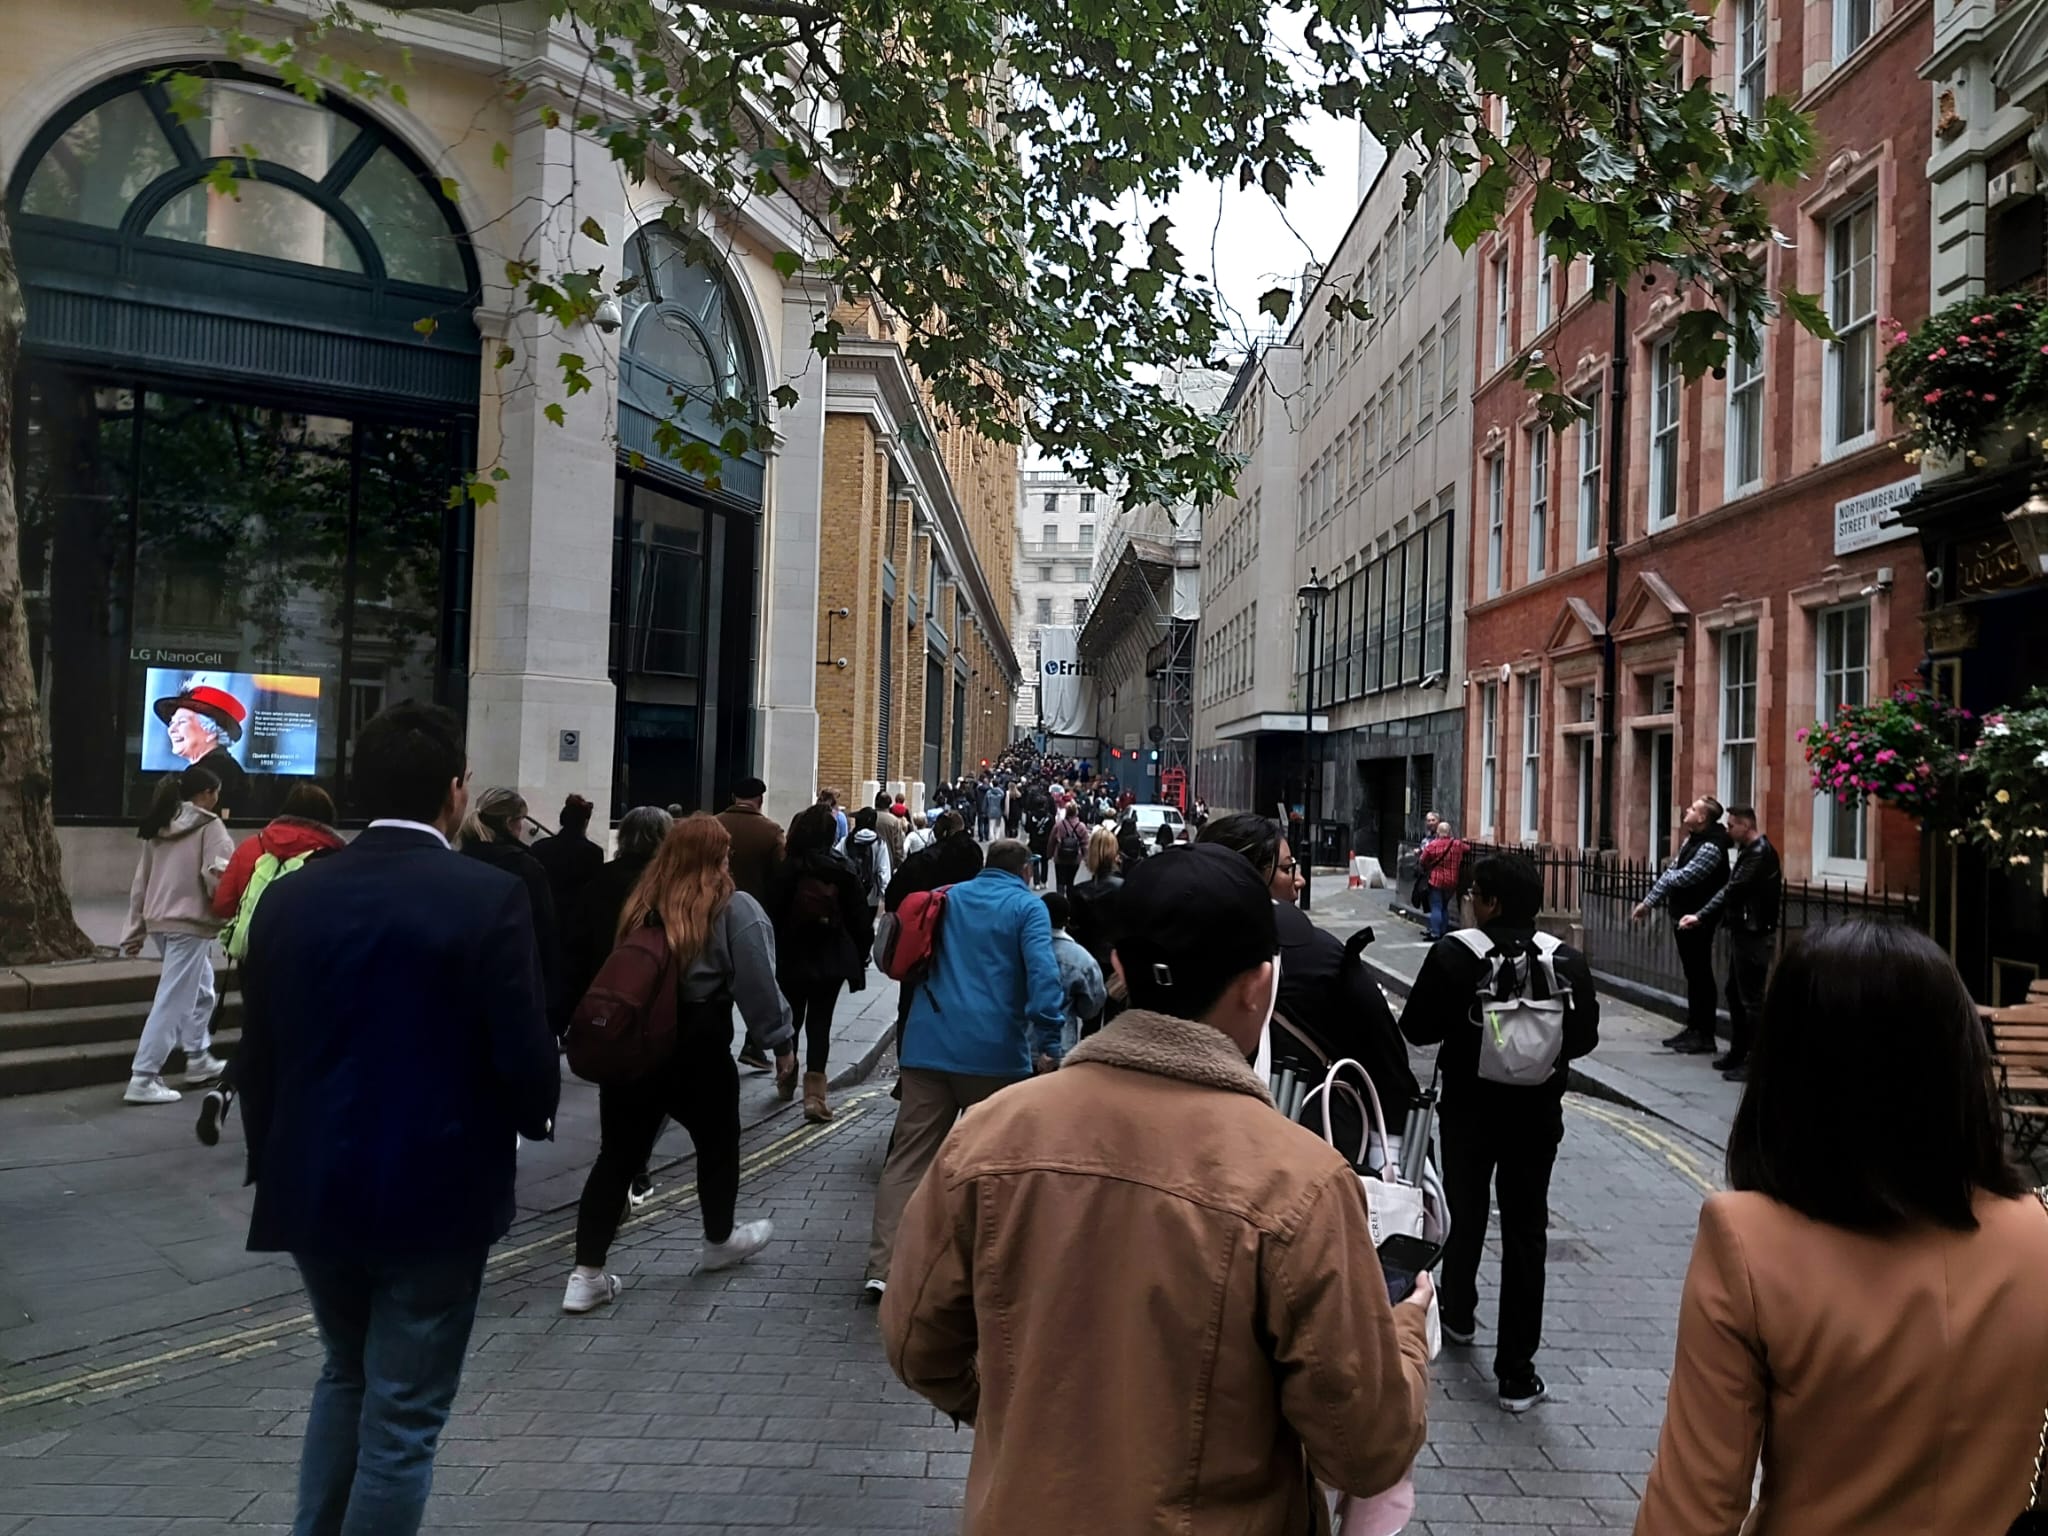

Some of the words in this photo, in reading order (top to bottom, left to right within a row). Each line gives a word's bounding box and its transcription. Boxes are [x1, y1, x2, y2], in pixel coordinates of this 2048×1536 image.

[1839, 482, 1917, 519] NORTHUMBERLAND
[1839, 515, 1867, 537] STREET
[130, 648, 150, 660] LG
[156, 650, 222, 665] NanoCell
